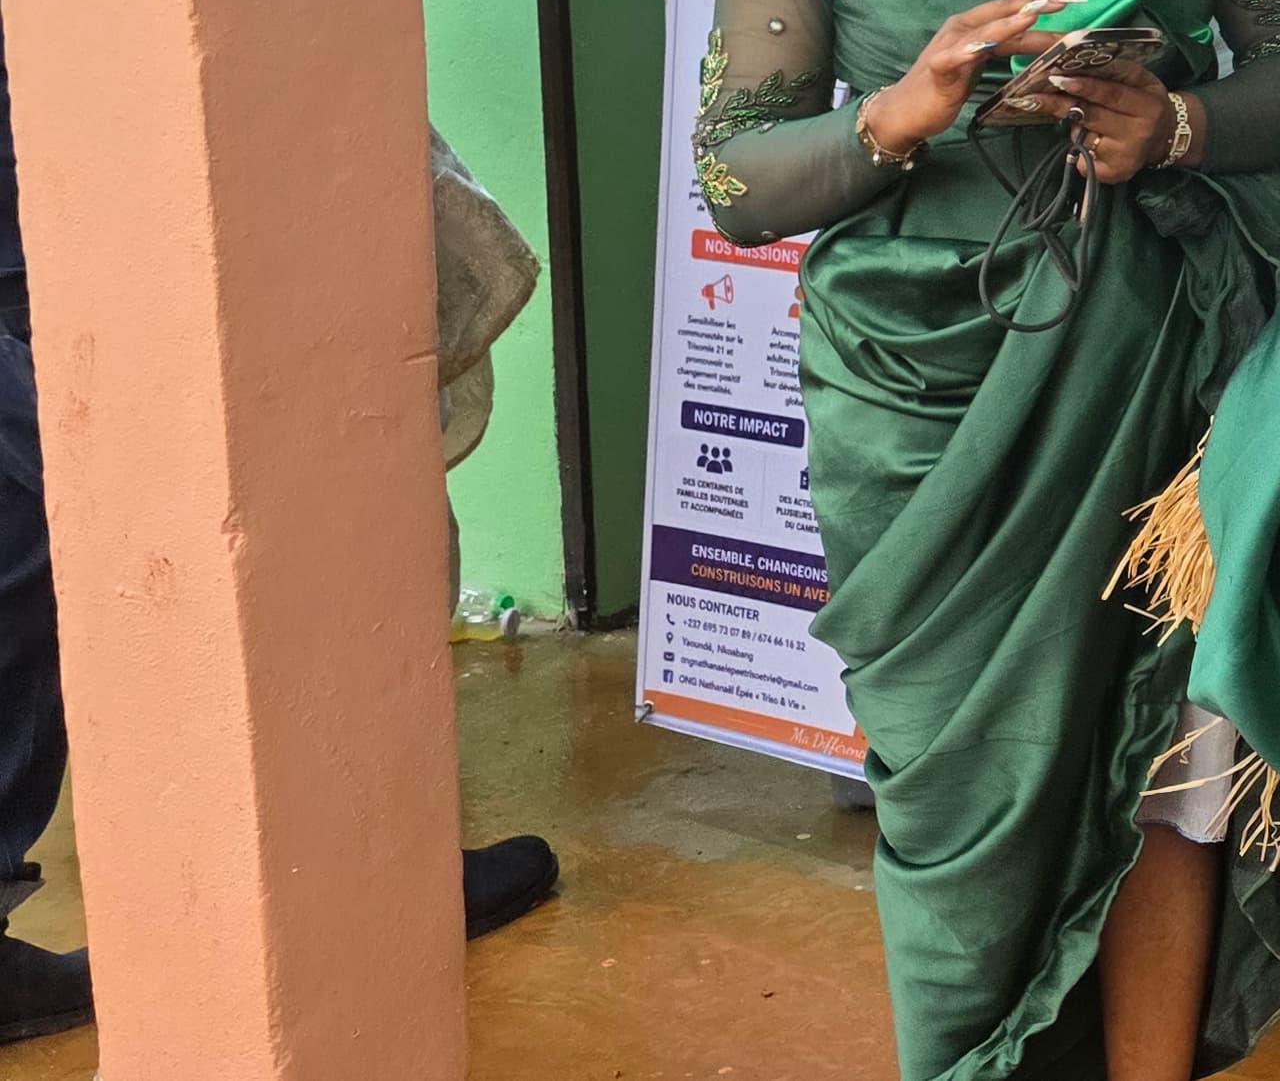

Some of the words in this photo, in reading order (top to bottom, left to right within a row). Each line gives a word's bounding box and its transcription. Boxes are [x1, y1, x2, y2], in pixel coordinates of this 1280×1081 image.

[705, 239, 732, 256] NOS
[735, 245, 799, 265] MISSIONS
[716, 345, 724, 355] 21
[694, 409, 737, 430] NOTRE
[740, 417, 789, 438] IMPACT
[677, 488, 708, 501] FAMILLES
[682, 477, 696, 487] DES
[697, 479, 734, 493] CENTAINES
[735, 486, 744, 496] DE
[680, 501, 689, 509] ET
[779, 494, 792, 504] DES
[785, 520, 795, 529] DU
[692, 544, 755, 570] ENSEMBLE,
[758, 556, 828, 582] CHANGEONS
[691, 563, 781, 592] CONSTRUISONS
[784, 582, 801, 597] UN
[667, 593, 696, 609] NOUS
[699, 599, 759, 621] CONTACTER
[679, 674, 697, 687] ONG
